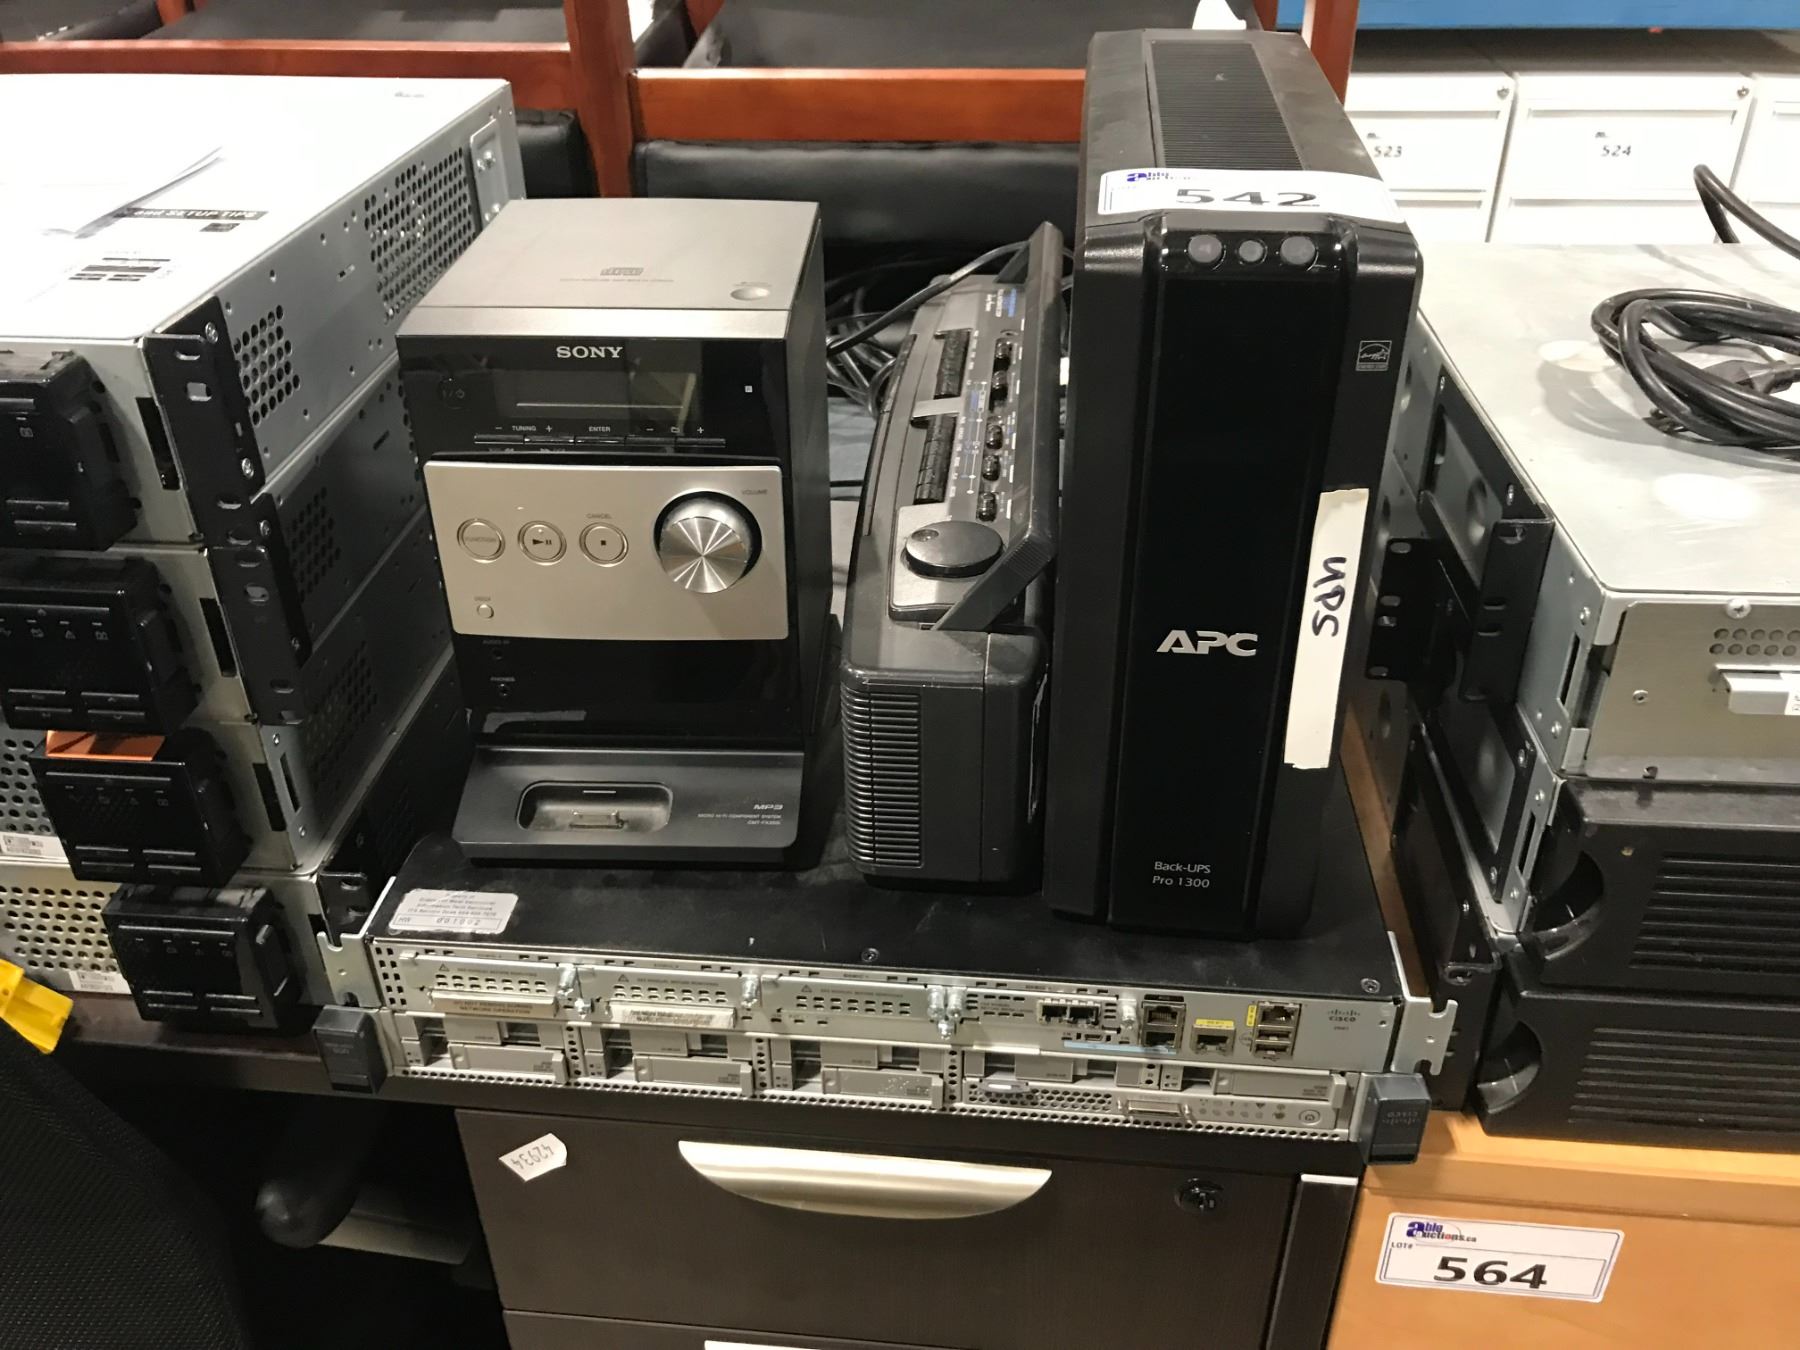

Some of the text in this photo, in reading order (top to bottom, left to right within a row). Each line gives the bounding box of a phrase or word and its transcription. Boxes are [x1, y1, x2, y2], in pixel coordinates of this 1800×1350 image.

[1373, 145, 1402, 158] 523
[1601, 145, 1632, 158] 524
[1176, 188, 1320, 207] 542
[165, 209, 218, 218] SETUP
[221, 210, 257, 218] TIPS
[556, 346, 623, 359] SONY
[1156, 629, 1258, 657] APC
[1154, 861, 1211, 874] Back-UPS
[1152, 875, 1210, 888] Pro 1300
[510, 1143, 554, 1170] 42934
[1391, 1241, 1414, 1249] LOT#
[1433, 1256, 1548, 1289] 564
